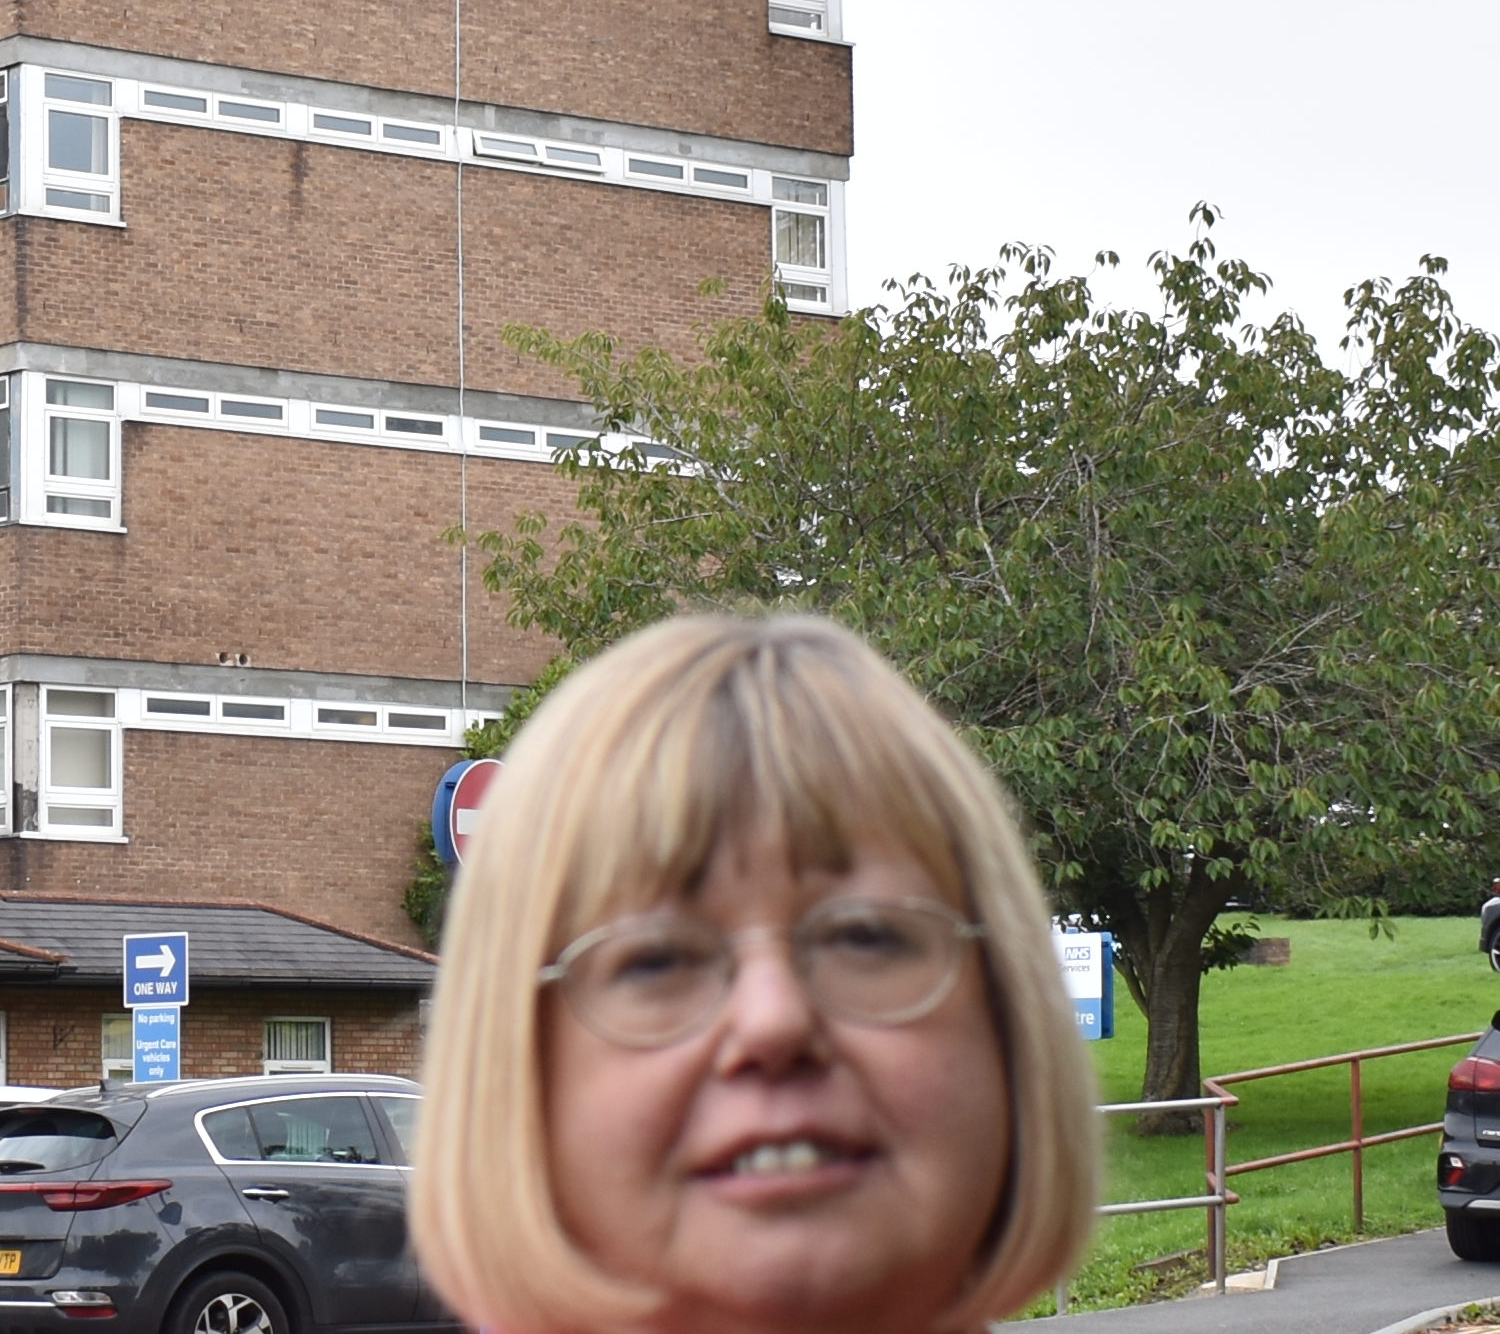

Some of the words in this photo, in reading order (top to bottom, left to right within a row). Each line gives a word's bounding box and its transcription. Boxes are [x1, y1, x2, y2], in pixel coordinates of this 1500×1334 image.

[1066, 948, 1090, 960] NHS
[134, 982, 154, 996] ONE
[155, 981, 178, 995] WAY
[138, 1014, 148, 1024] No
[149, 1013, 175, 1025] parking
[136, 1040, 159, 1052] Urgent
[160, 1039, 177, 1049] Care
[142, 1052, 171, 1063] vehicles
[148, 1065, 164, 1078] only
